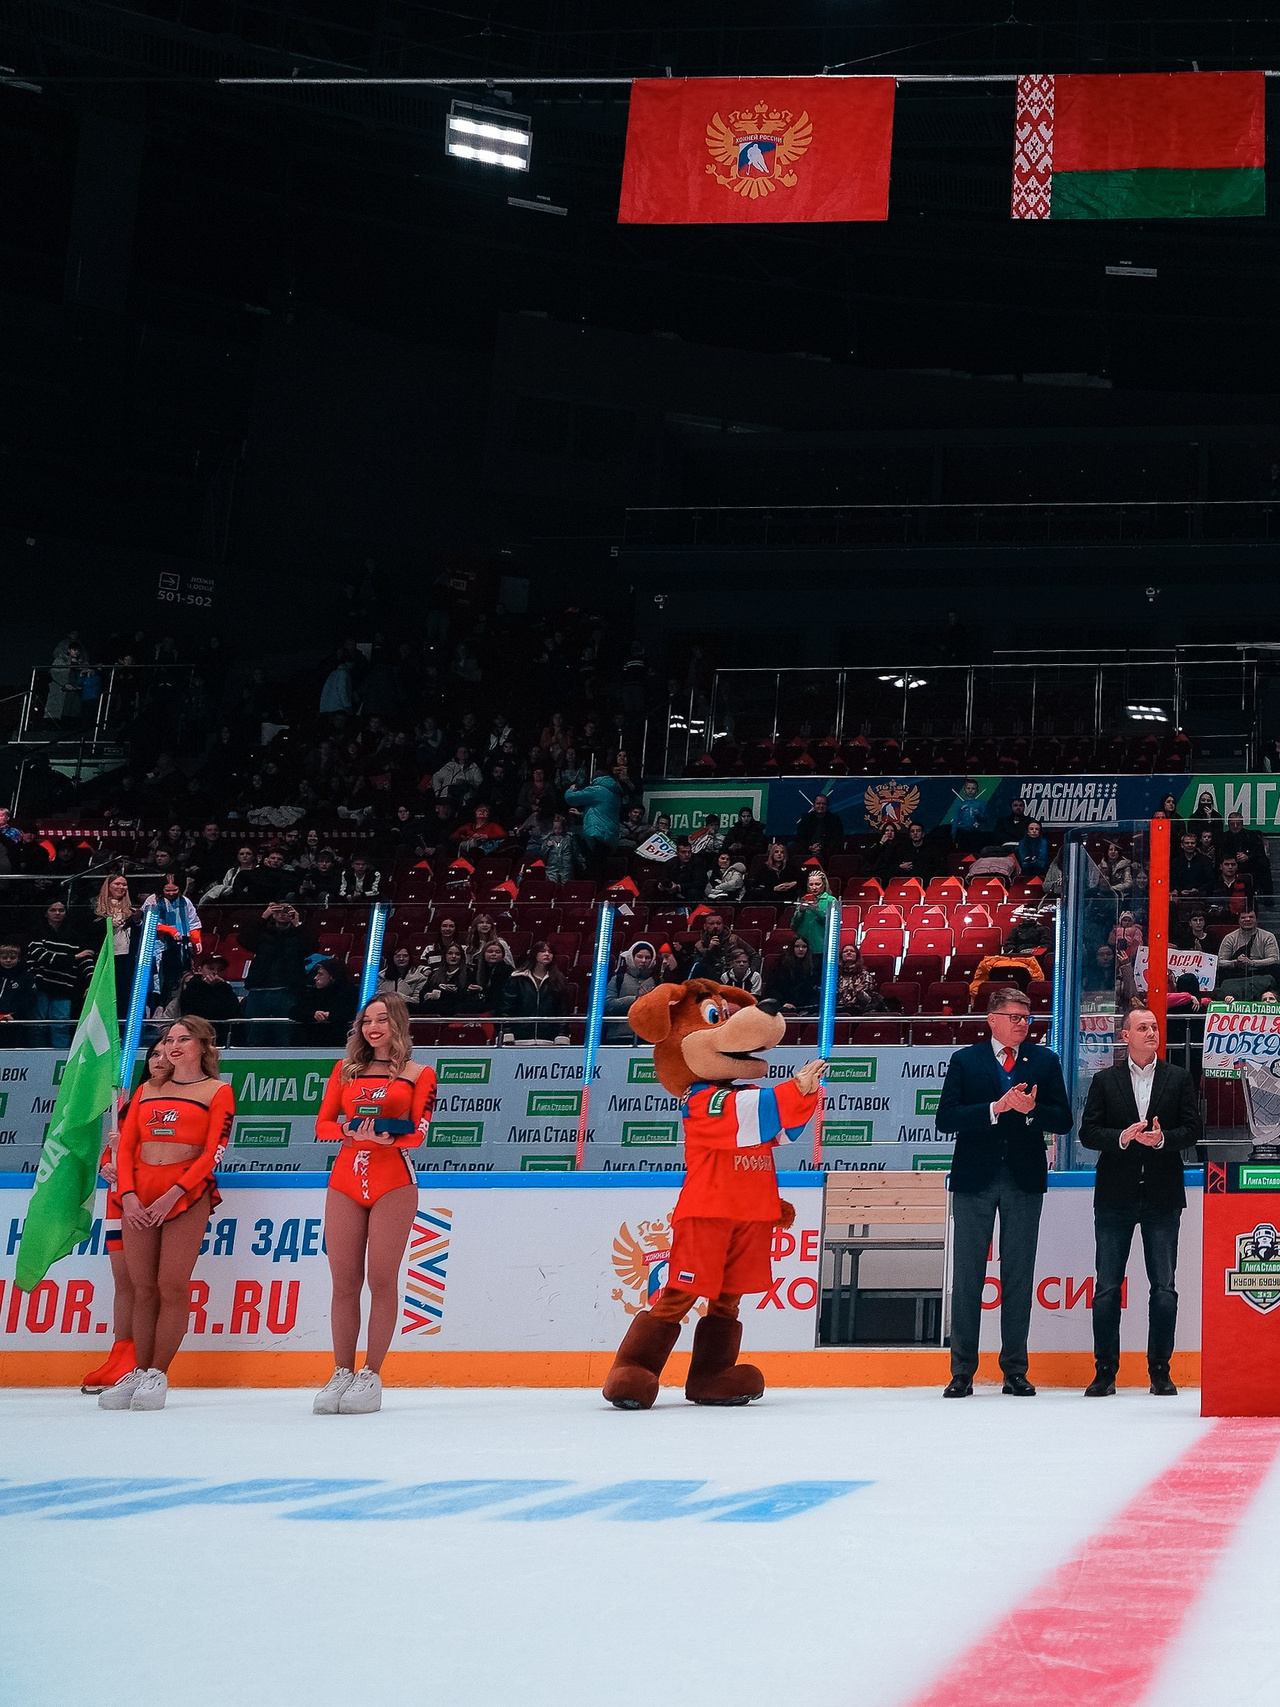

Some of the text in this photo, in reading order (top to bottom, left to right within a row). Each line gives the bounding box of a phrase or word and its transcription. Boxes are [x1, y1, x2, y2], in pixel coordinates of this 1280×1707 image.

[156, 590, 213, 608] 501-502
[1020, 783, 1097, 798] КРАСНАЯ
[1023, 799, 1118, 821] МАШИНА
[1251, 1003, 1280, 1015] СТАВОК
[515, 1063, 550, 1079] ЛИГА
[901, 1062, 936, 1079] ЛИГА
[240, 1072, 297, 1102] ЛИГА
[450, 1095, 502, 1112] СТАВОК
[608, 1095, 641, 1111] ЛИГА
[838, 1094, 890, 1111] СТАВОК
[508, 1126, 543, 1142] ЛИГА
[898, 1125, 938, 1142] ЛИГА
[1247, 1177, 1262, 1186] ЛИГА
[1244, 1262, 1260, 1273] ЛИГА
[1233, 1277, 1257, 1287] КУБОК
